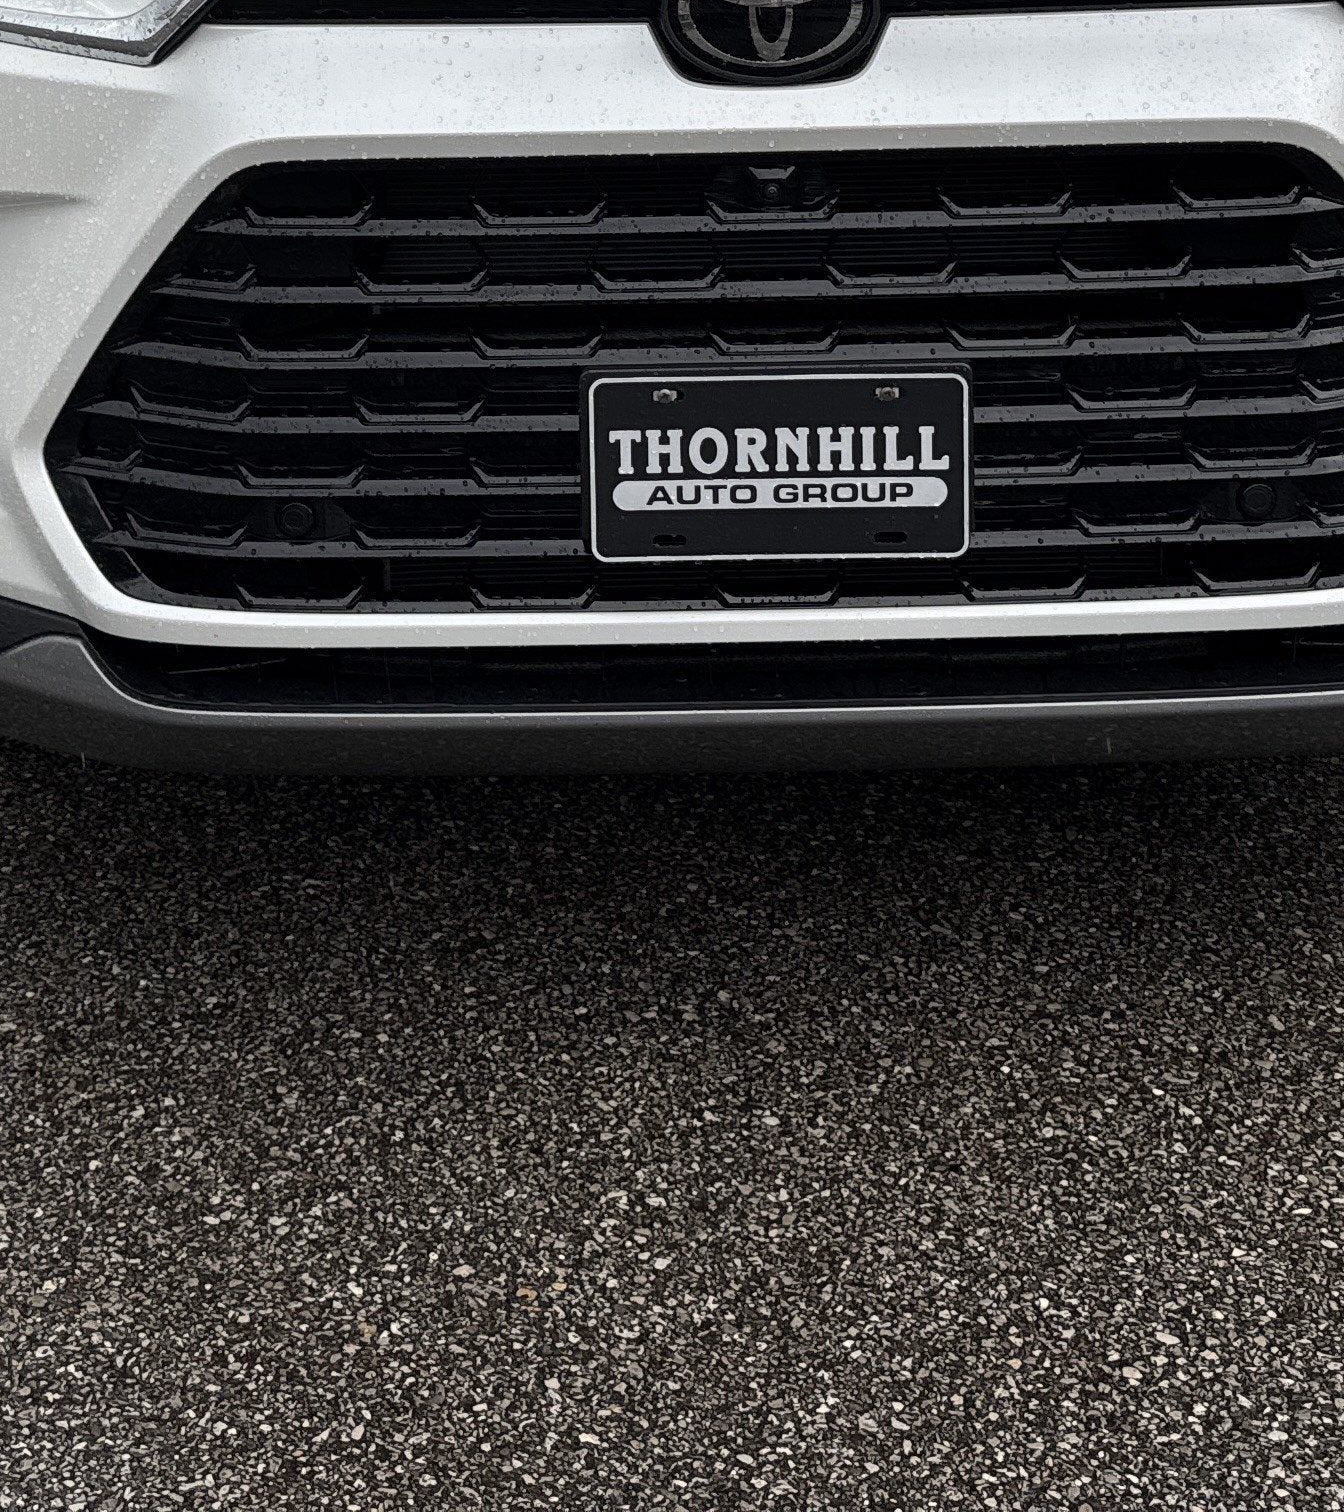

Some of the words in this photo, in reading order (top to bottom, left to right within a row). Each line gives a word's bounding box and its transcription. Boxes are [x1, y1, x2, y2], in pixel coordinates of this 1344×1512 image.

[608, 425, 950, 475] THORNHILL
[645, 483, 758, 506] AUTO
[772, 481, 915, 504] GROUP
